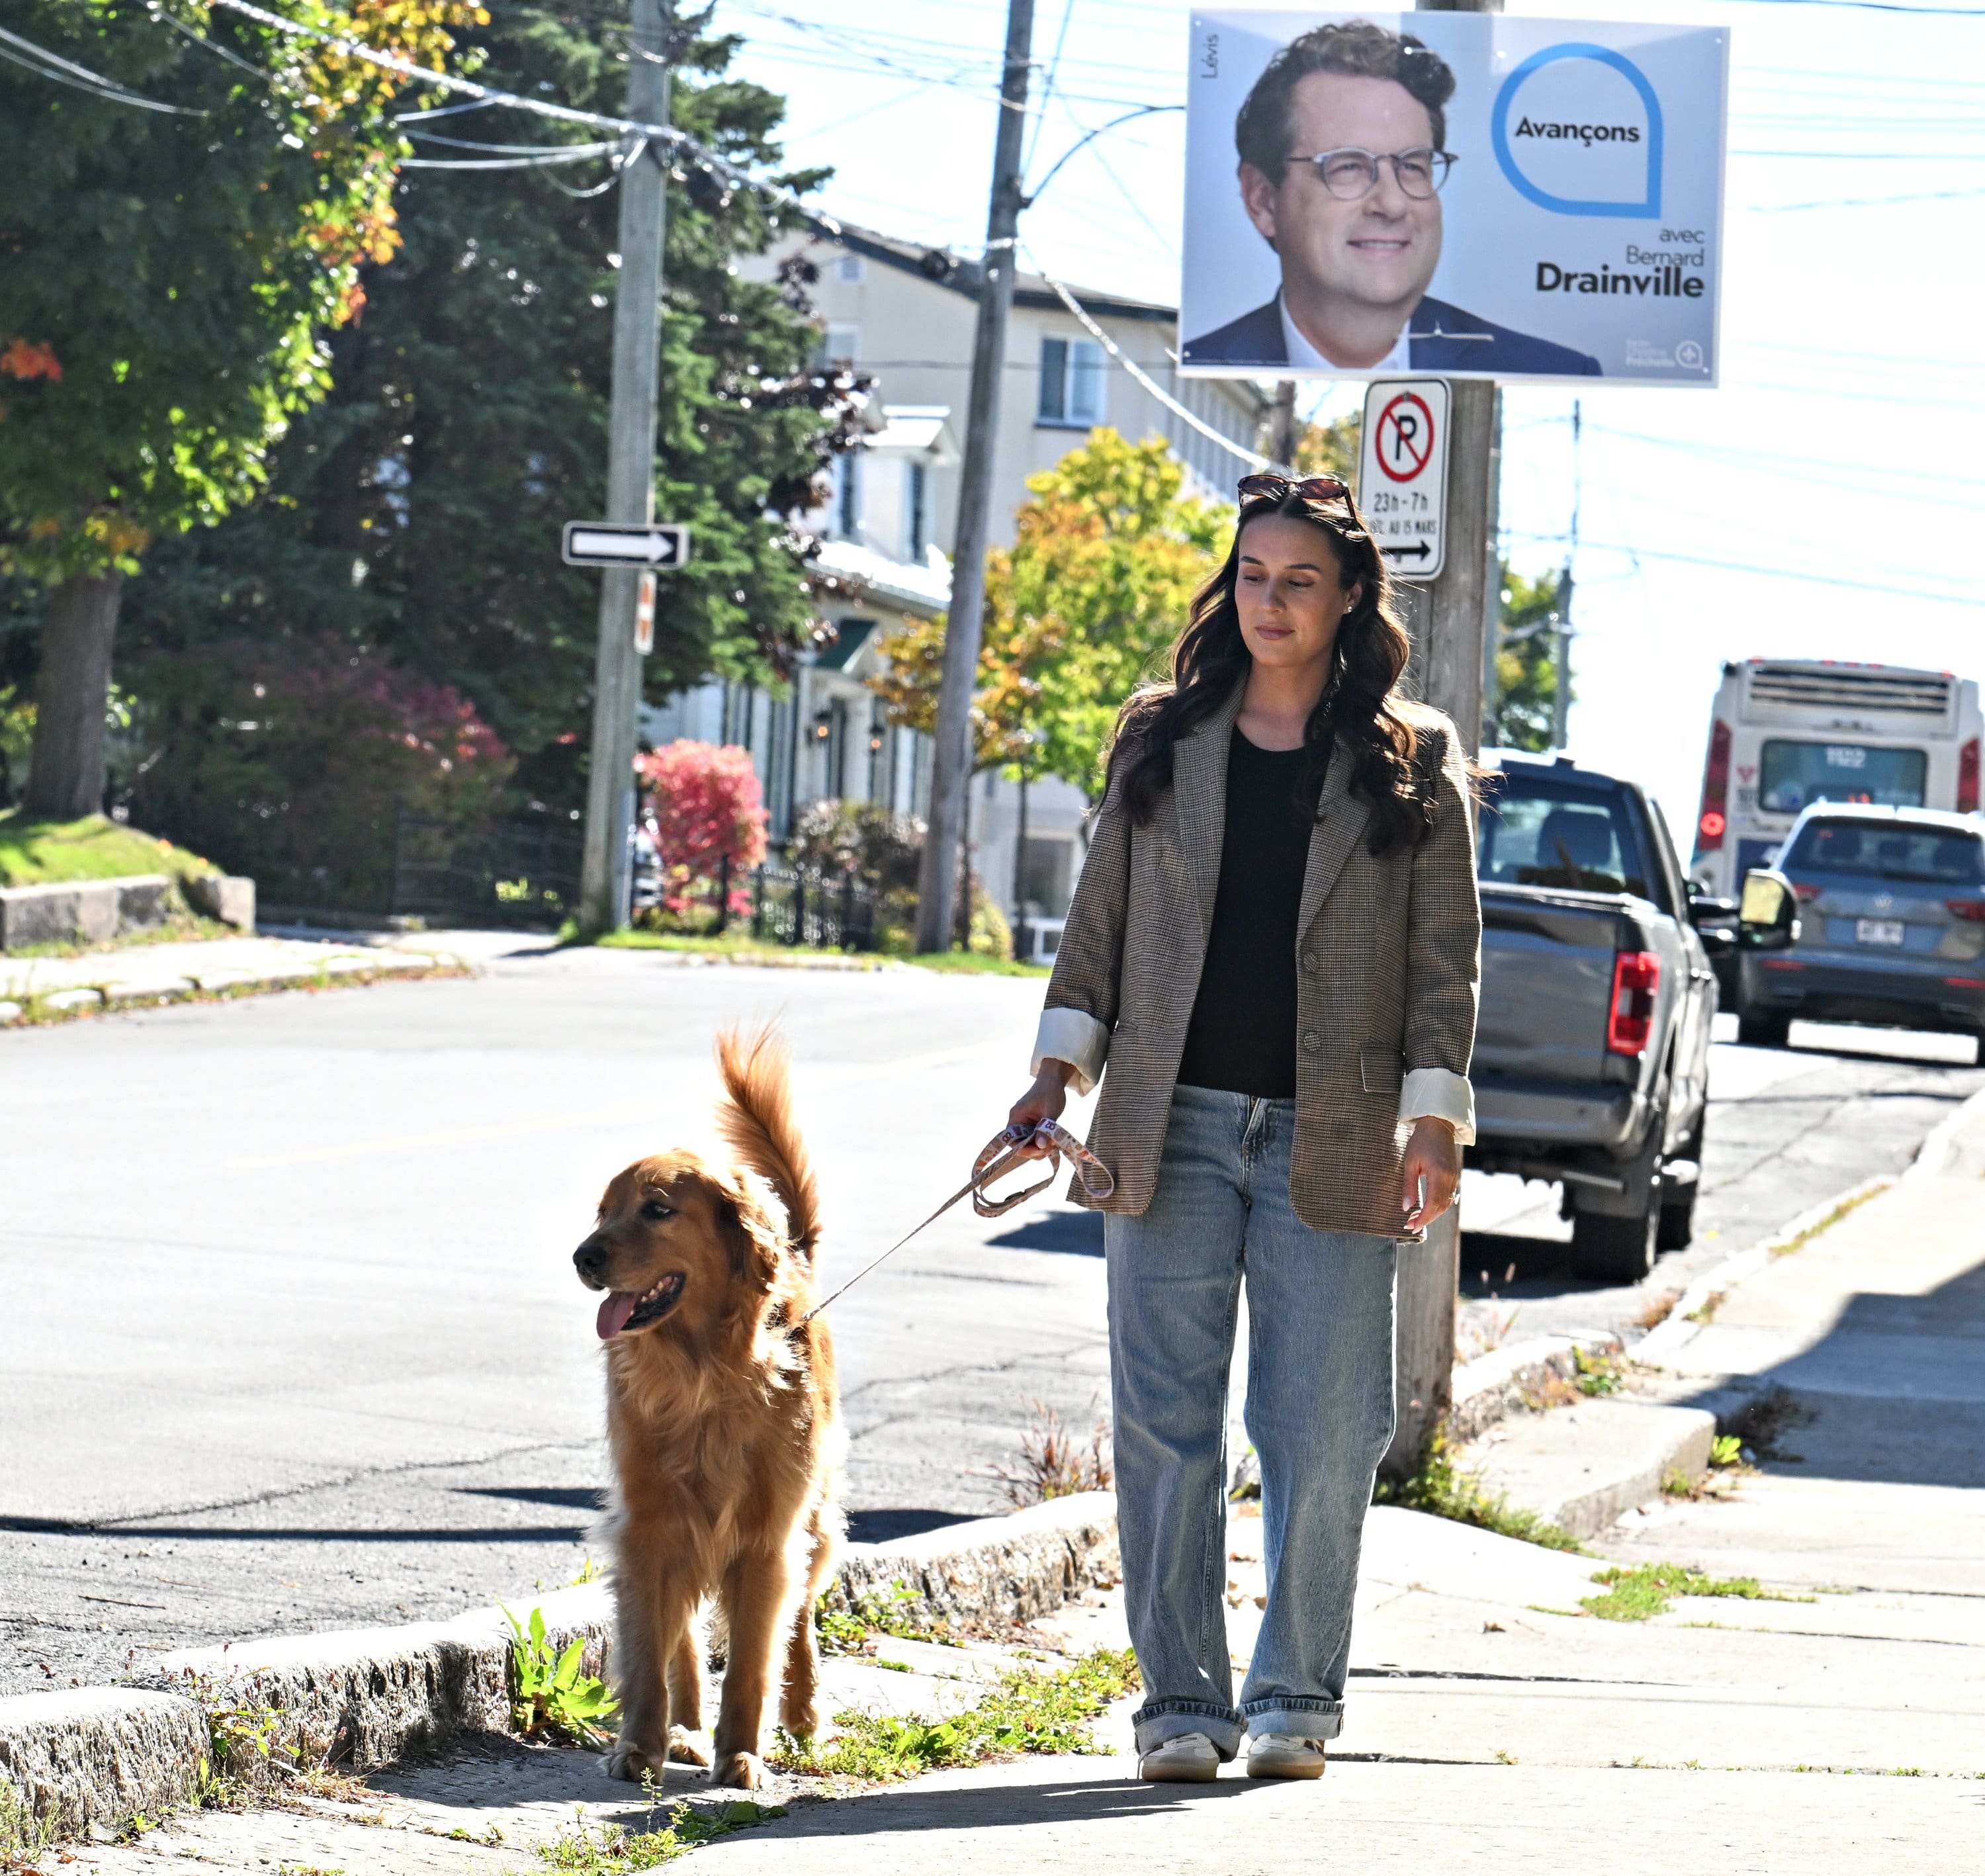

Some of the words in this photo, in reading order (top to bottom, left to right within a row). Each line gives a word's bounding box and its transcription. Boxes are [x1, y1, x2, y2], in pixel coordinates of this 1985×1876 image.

[1200, 34, 1219, 79] Lévis
[1515, 116, 1640, 148] Avançons
[1659, 228, 1705, 244] avec
[1626, 244, 1704, 266] Bernard
[1536, 261, 1704, 297] Drainville
[1415, 519, 1436, 535] MARS
